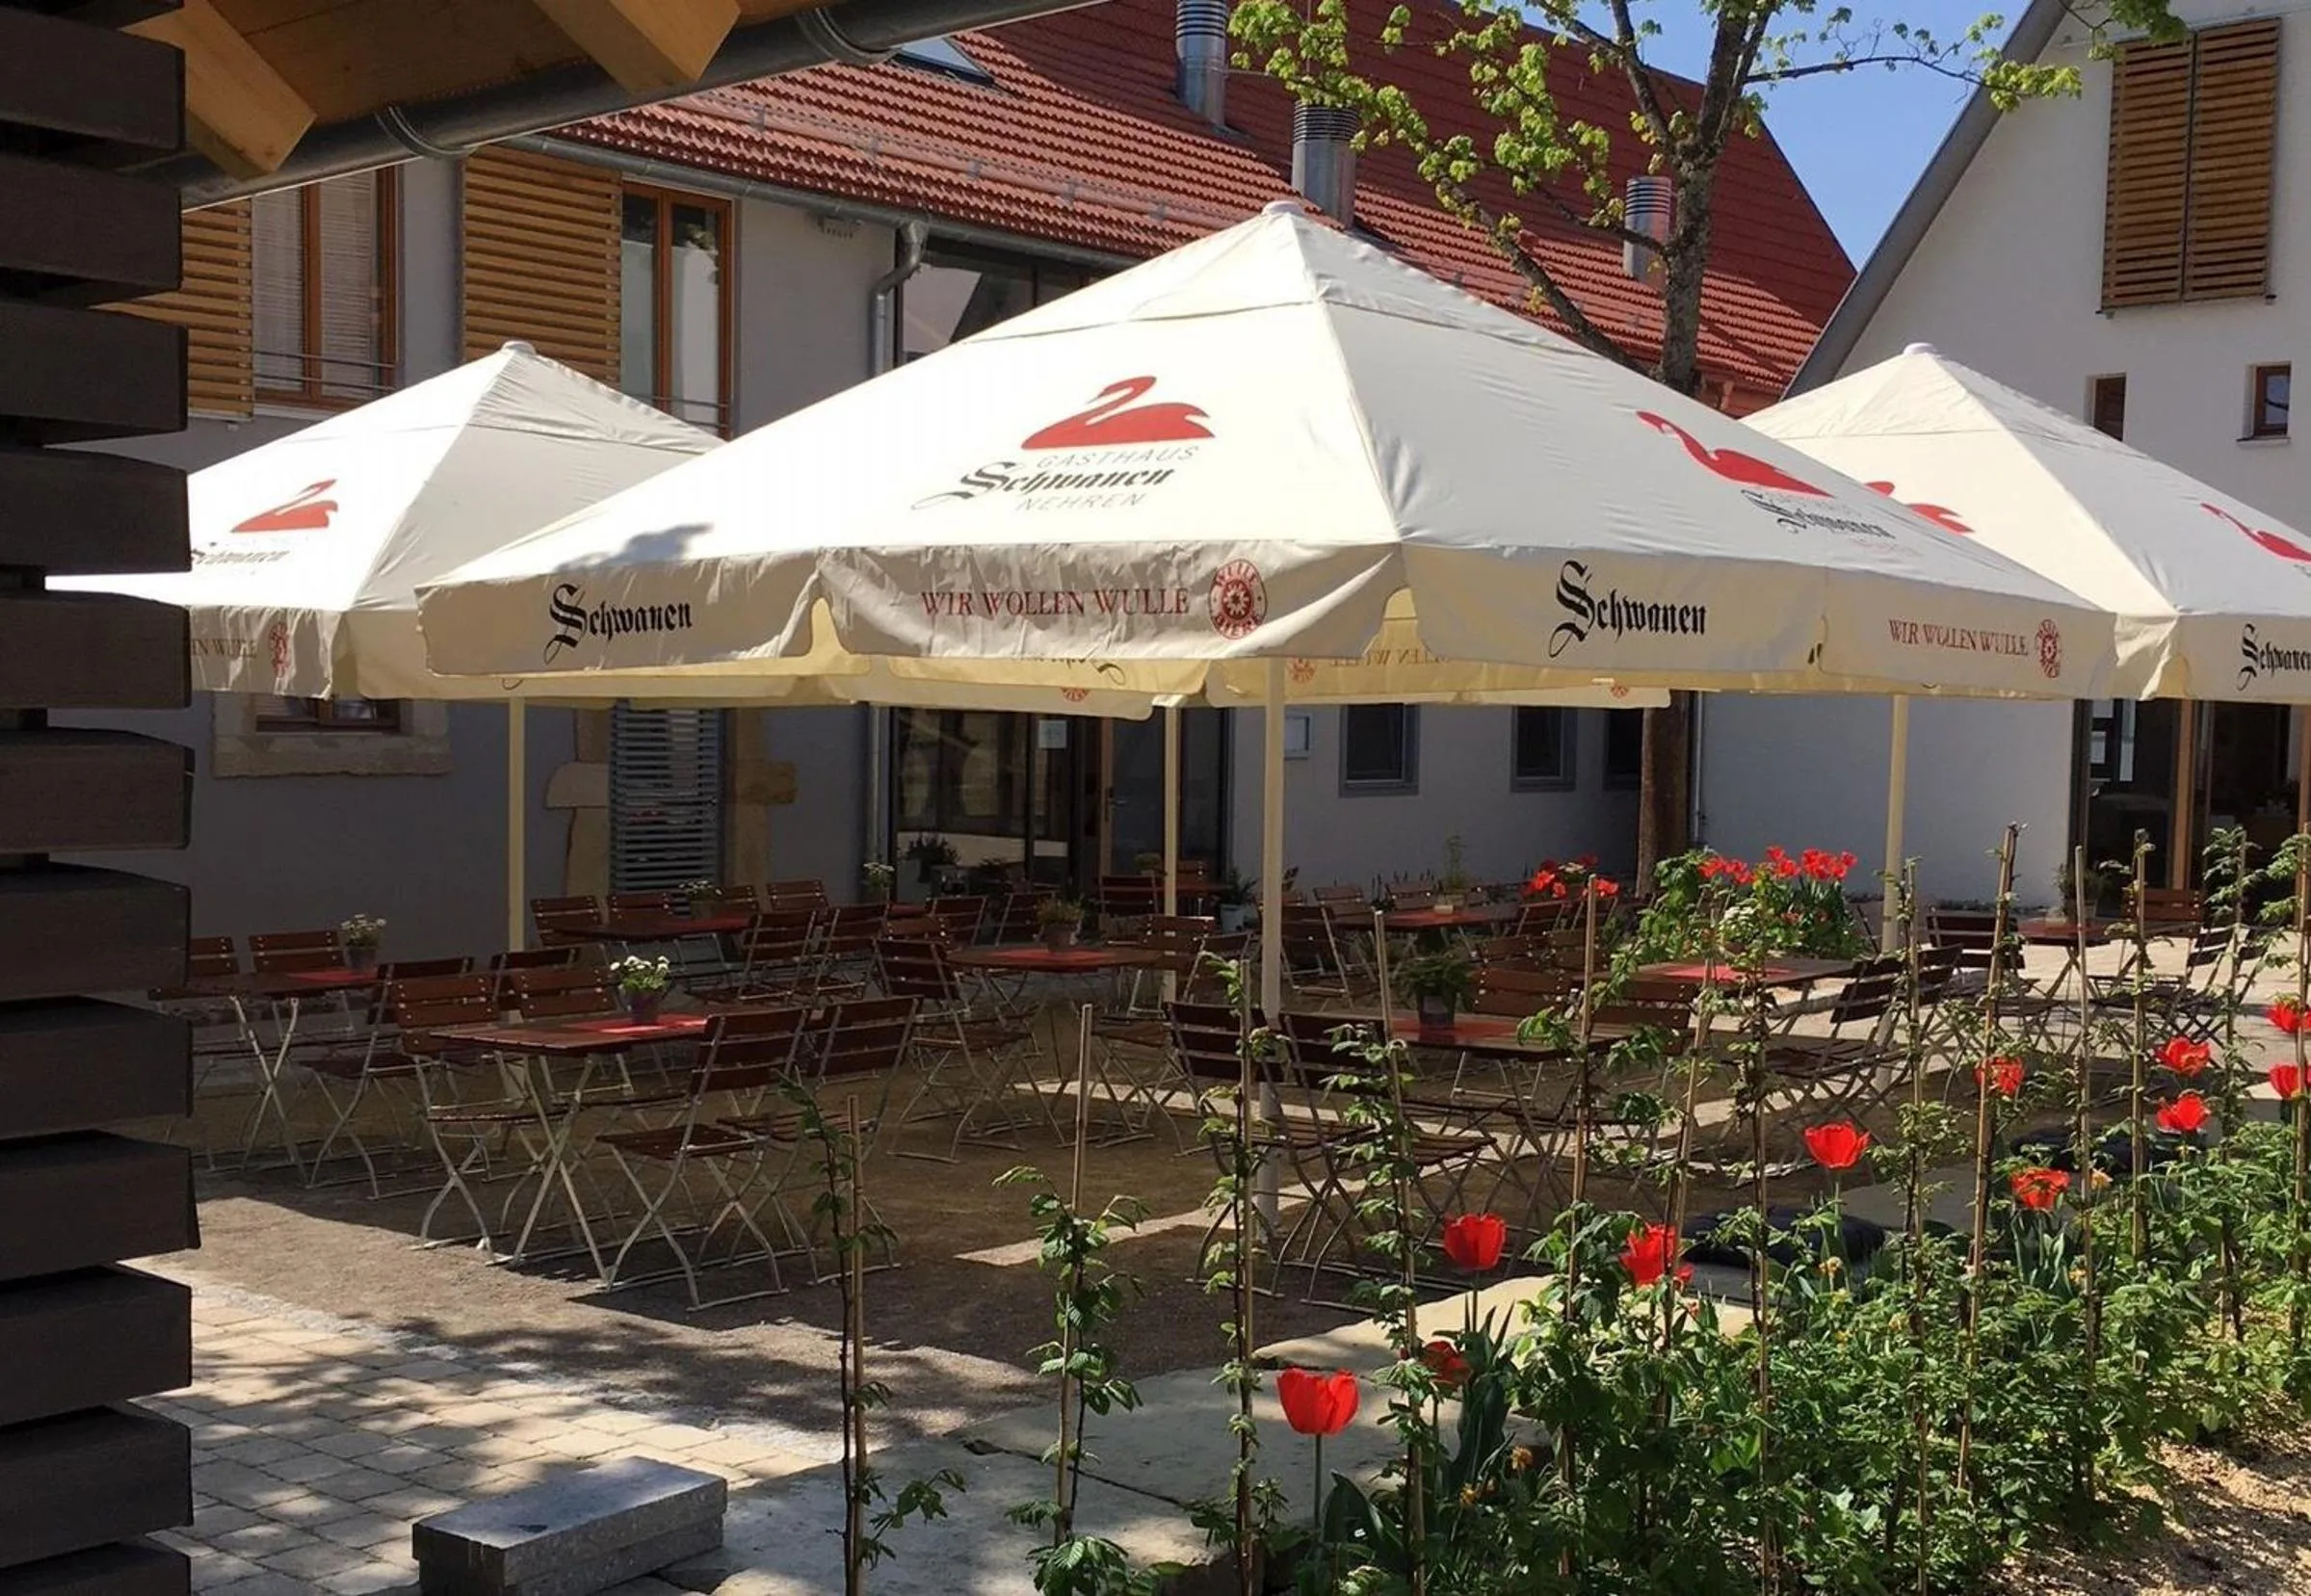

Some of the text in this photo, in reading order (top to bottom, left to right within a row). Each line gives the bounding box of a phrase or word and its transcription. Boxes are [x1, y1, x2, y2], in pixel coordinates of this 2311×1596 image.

[1036, 445, 1200, 469] GASTHAUS
[910, 461, 1175, 510] Schwanen
[1014, 492, 1147, 511] NEHREN
[920, 588, 1191, 619] WIR WOLLEN WULLE
[1548, 560, 1708, 658] Schwanen
[542, 583, 694, 666] Schwanen
[1888, 619, 1920, 645] WIR
[1922, 623, 1978, 651] WOLLEN
